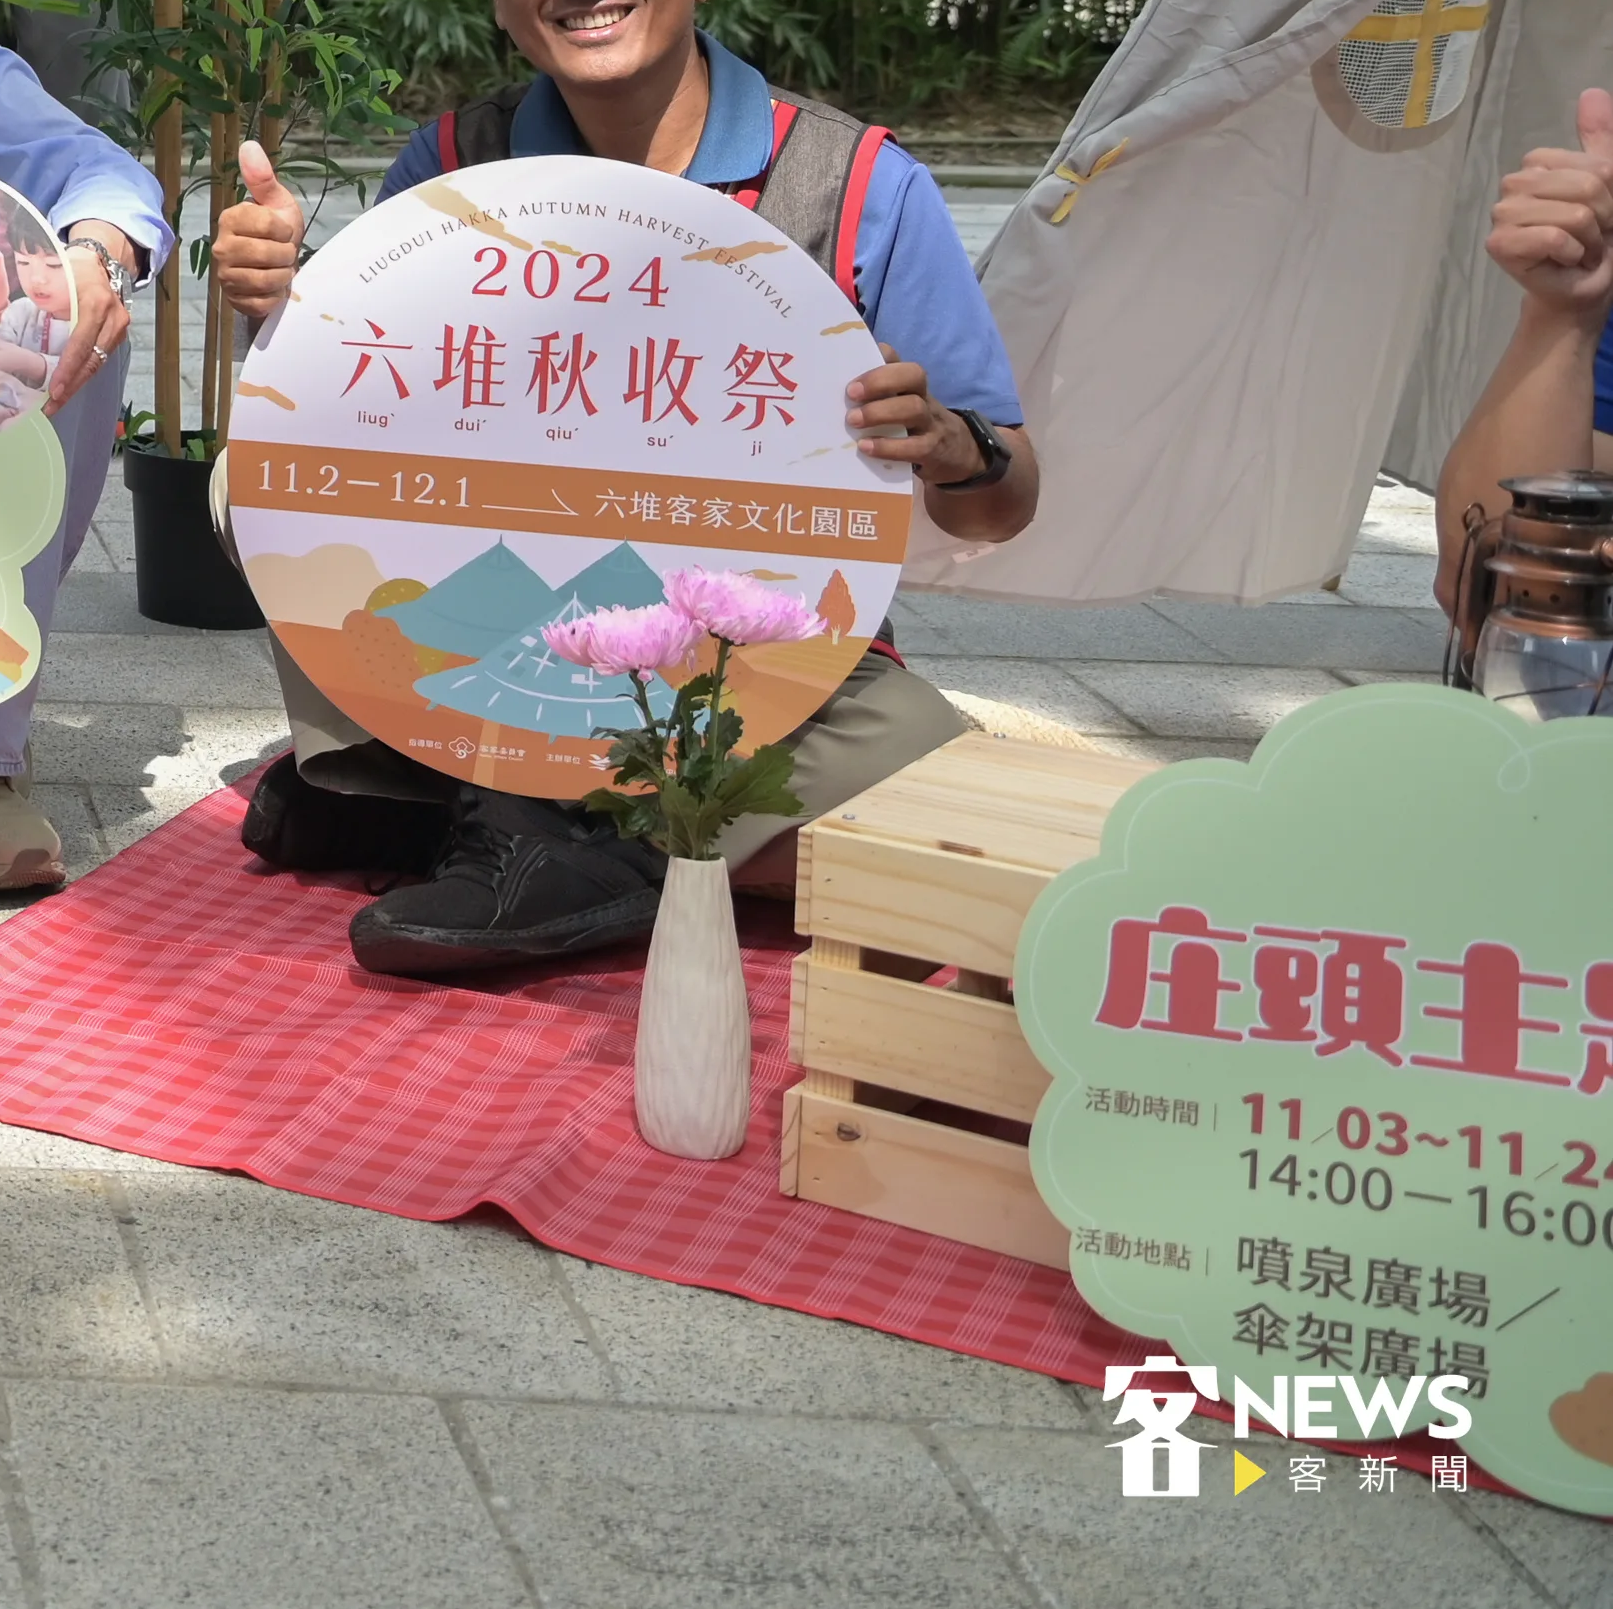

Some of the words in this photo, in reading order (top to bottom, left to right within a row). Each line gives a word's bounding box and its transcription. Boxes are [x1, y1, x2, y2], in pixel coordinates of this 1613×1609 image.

[359, 231, 434, 284] LIUGDUI
[441, 208, 509, 237] HAKKA
[518, 201, 607, 218] AUTUMN
[618, 209, 710, 252] HARVEST
[713, 248, 793, 319] FESTIVAL
[472, 247, 670, 307] 2024
[340, 319, 799, 432] 六堆秋收祭
[750, 440, 762, 456] ji
[594, 488, 879, 542] 六堆客家文化園區
[1095, 905, 1613, 1096] 庄頭主
[1084, 1085, 1200, 1128] 活動時間
[1242, 1092, 1613, 1190] 11/03~11/2
[1075, 1226, 1192, 1272] 活動地點
[1231, 1301, 1491, 1400] 傘架廣場
